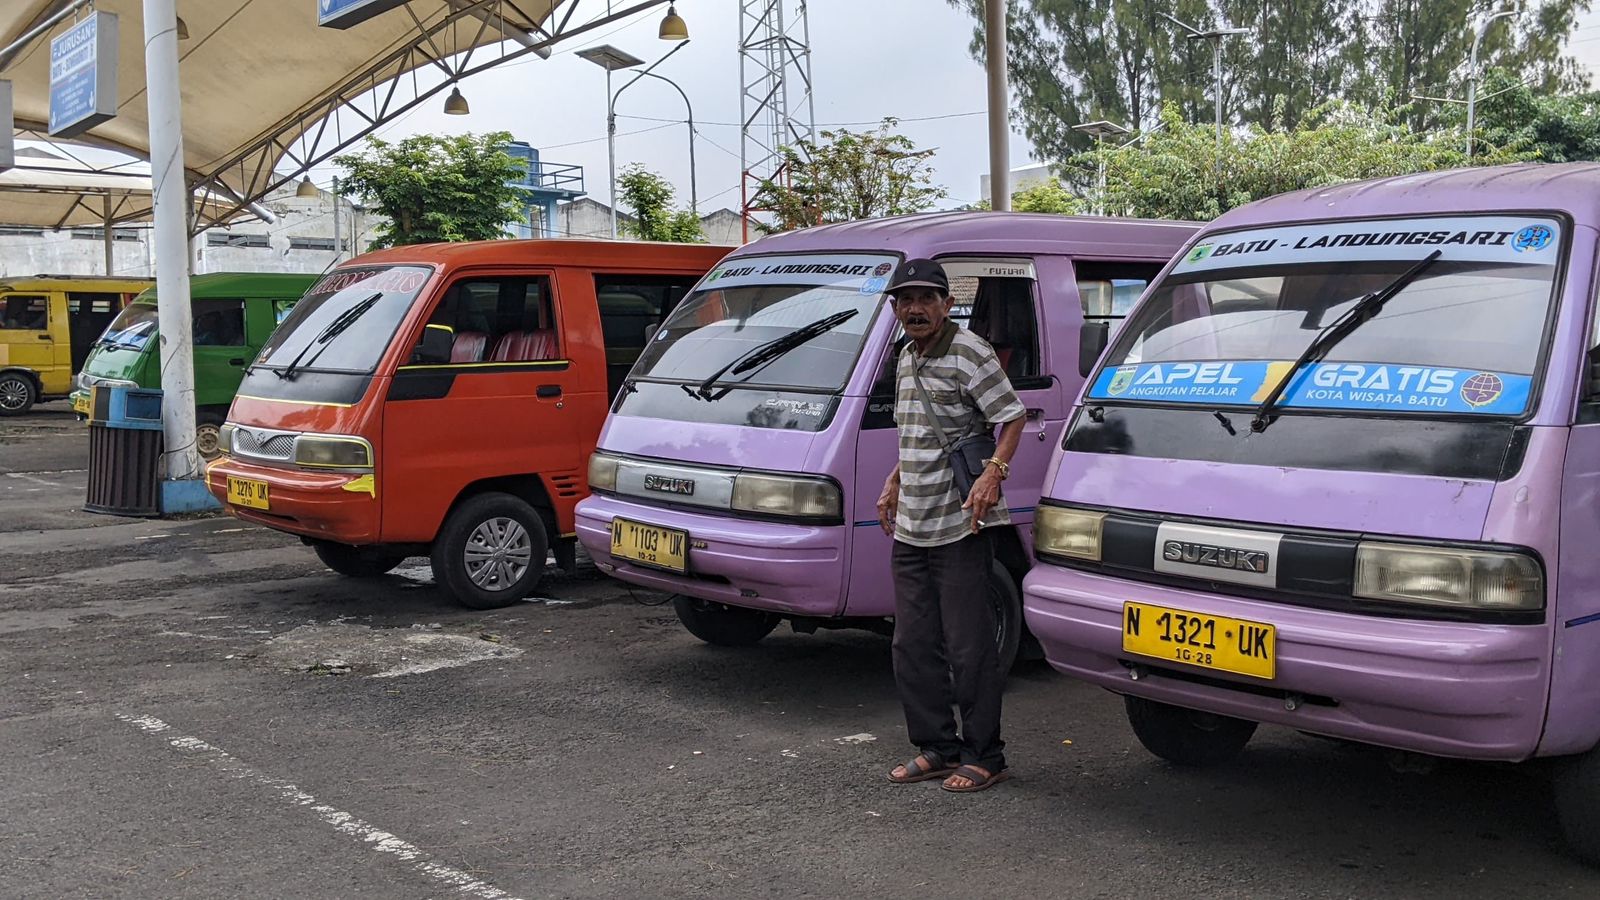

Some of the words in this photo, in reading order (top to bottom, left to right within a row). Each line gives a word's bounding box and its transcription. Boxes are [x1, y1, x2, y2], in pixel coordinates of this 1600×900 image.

[57, 24, 91, 57] JURUSAN
[1210, 239, 1278, 257] BATU
[1293, 231, 1514, 249] LANDUNGSARI
[720, 266, 756, 279] BATU
[760, 264, 874, 276] LANDUNGSARI
[989, 267, 1025, 275] FUTURA
[1134, 363, 1243, 385] APEL
[1313, 364, 1459, 394] GRATIS
[1128, 386, 1188, 396] ANGKUTAN
[1189, 386, 1238, 397] PELAJAR
[1306, 389, 1343, 400] KOTA
[1350, 391, 1403, 404] WISATA
[1408, 395, 1448, 407] BATU
[227, 478, 233, 494] N
[236, 480, 253, 497] 1276
[257, 483, 267, 500] UK
[644, 475, 693, 494] SUZUKI
[613, 522, 622, 544] N
[634, 526, 658, 551] 1103
[669, 533, 683, 556] UK
[1164, 541, 1266, 572] SUZUKI
[1127, 606, 1141, 636] N
[1159, 612, 1216, 650] 1321
[1238, 625, 1268, 659] UK
